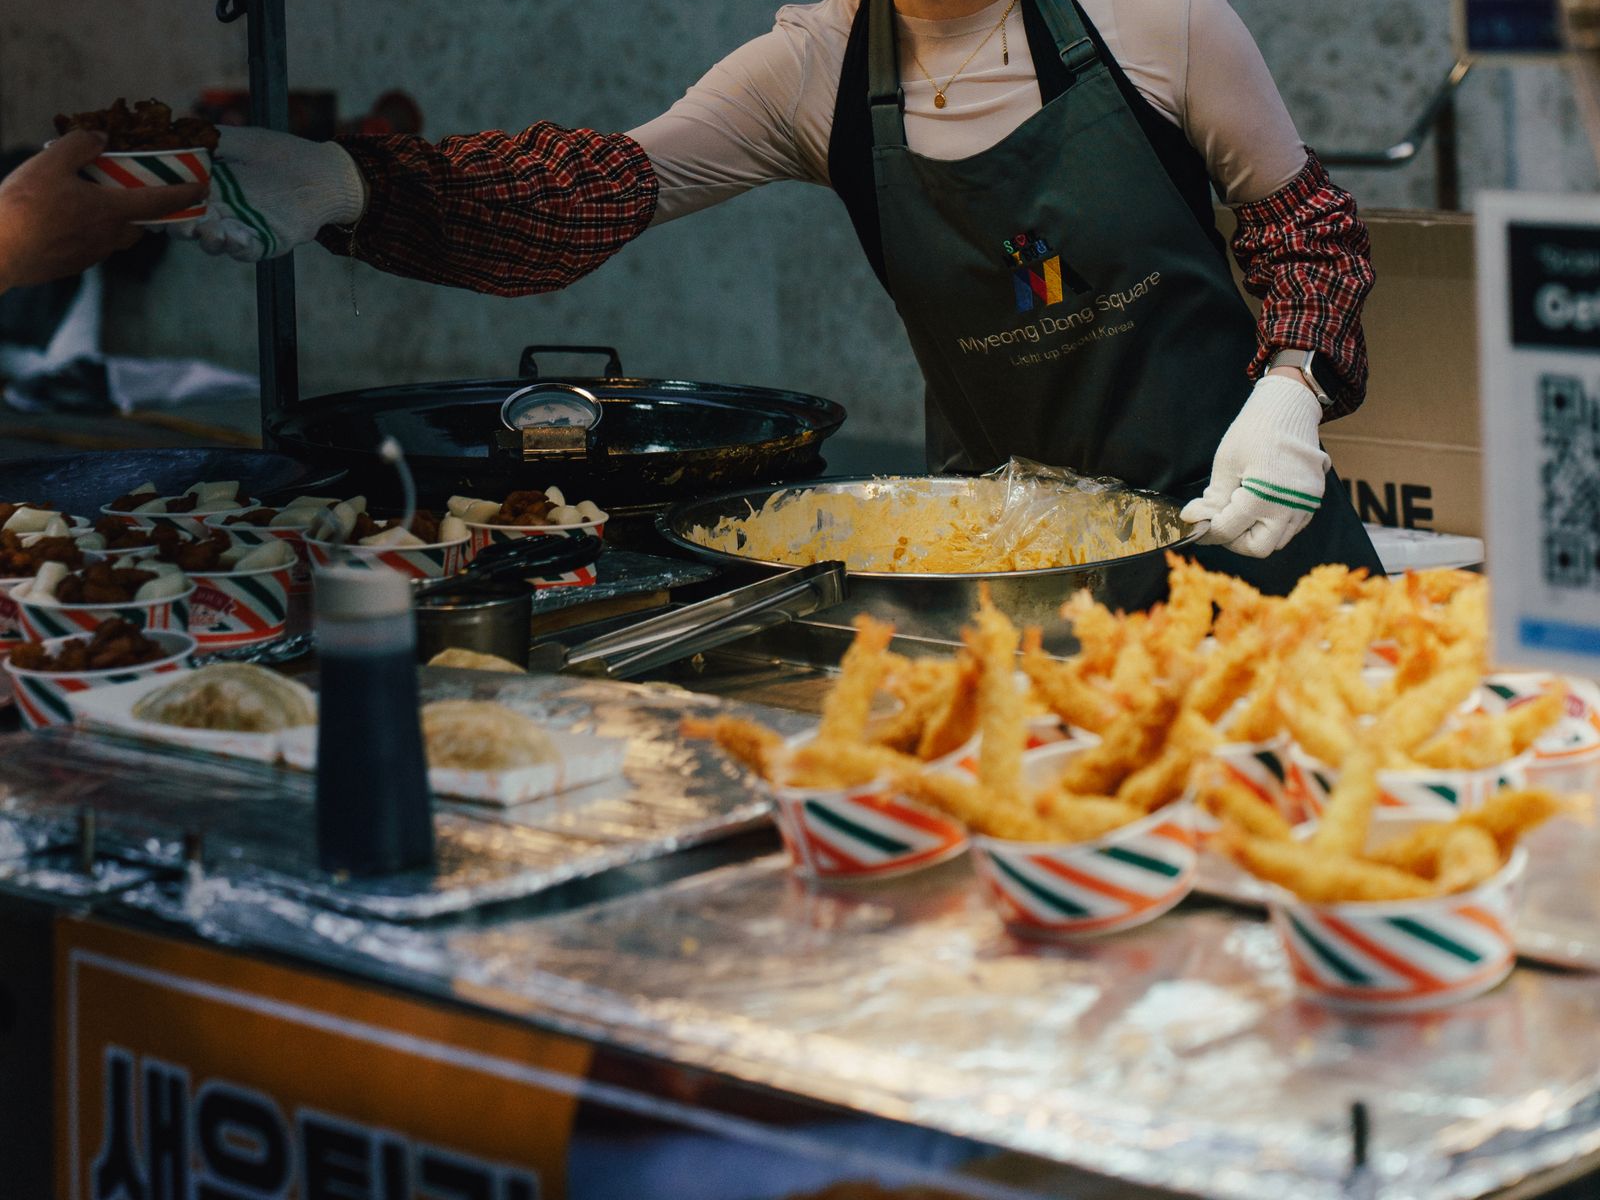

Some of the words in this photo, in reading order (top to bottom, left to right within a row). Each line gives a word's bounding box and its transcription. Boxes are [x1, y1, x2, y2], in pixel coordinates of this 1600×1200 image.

[958, 323, 1040, 355] Myeong
[1039, 307, 1095, 336] Dong
[1095, 270, 1161, 312] Square
